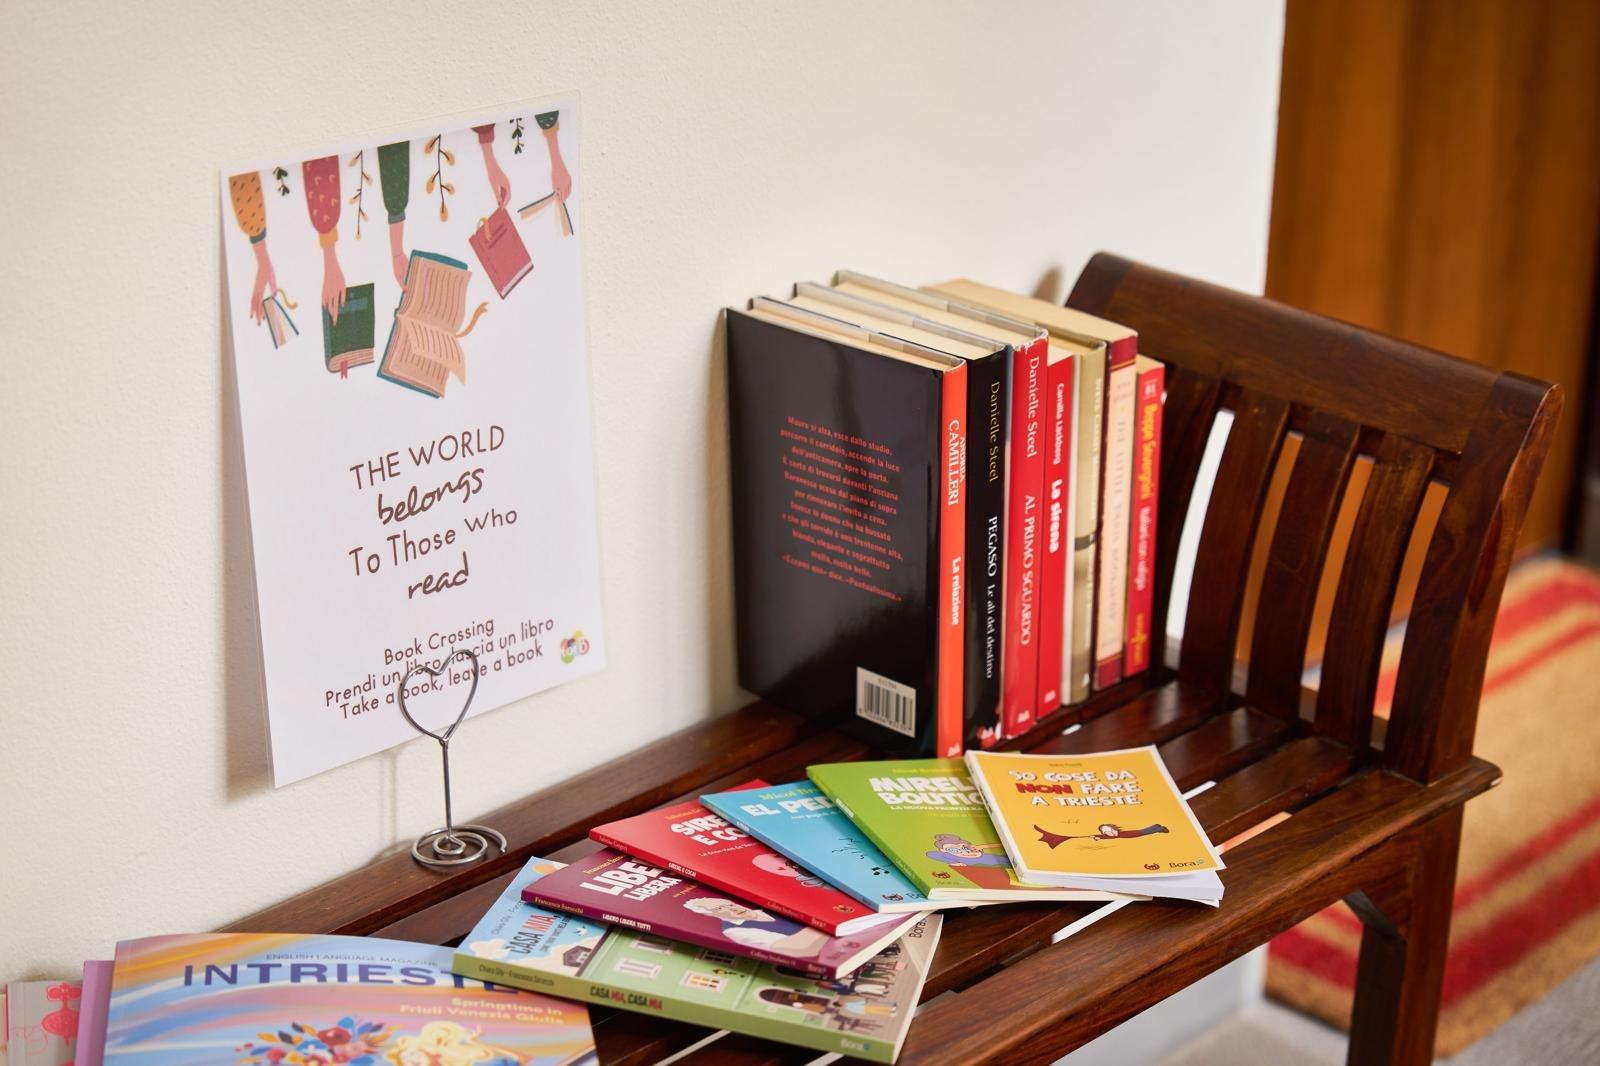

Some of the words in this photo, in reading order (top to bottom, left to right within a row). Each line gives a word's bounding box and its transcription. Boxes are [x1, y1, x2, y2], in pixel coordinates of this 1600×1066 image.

[1026, 356, 1040, 420] Danielle
[990, 381, 1000, 444] Danielle
[1055, 383, 1065, 425] Camilla
[1026, 422, 1038, 458] Steel
[350, 452, 400, 489] THE
[408, 425, 504, 466] WORLD
[948, 420, 960, 506] CAMILLERI
[990, 446, 999, 482] Steel
[378, 468, 484, 525] belongs
[1024, 495, 1036, 514] AL
[1051, 480, 1063, 500] La
[1050, 502, 1060, 552] sirena
[349, 546, 380, 576] To
[387, 530, 456, 566] Those
[986, 516, 998, 577] PEGASO
[1023, 517, 1036, 568] PRIMO
[408, 552, 469, 599] read
[952, 556, 961, 574] La
[952, 577, 962, 626] relazione
[988, 584, 996, 597] Le
[988, 600, 996, 614] ali
[1021, 570, 1034, 645] SGUARDO
[987, 616, 996, 635] del
[384, 637, 422, 665] Book
[428, 620, 494, 650] Crossing
[986, 636, 996, 679] destino
[326, 674, 376, 707] Prendi
[382, 672, 400, 686] un
[451, 640, 494, 664] lascia
[500, 634, 516, 648] un
[521, 619, 554, 641] libro
[340, 696, 378, 718] Take
[386, 692, 394, 704] a
[450, 664, 487, 686] leave
[494, 658, 502, 671] a
[507, 639, 543, 667] book
[868, 776, 977, 792] MIREL
[1016, 783, 1073, 794] NON
[1080, 781, 1141, 793] FARE
[1044, 772, 1097, 781] COSE
[1104, 770, 1136, 780] DA
[740, 803, 781, 816] EL
[1031, 796, 1049, 805] A
[1053, 794, 1142, 806] TRIESTE
[670, 814, 729, 836] SIRE
[690, 834, 719, 846] E
[712, 828, 750, 841] CO
[579, 861, 662, 896] LIBE
[623, 876, 682, 901] LIBERA
[602, 914, 619, 923] LIBERO
[620, 917, 636, 927] LIBERA
[637, 922, 652, 932] TUTTI
[506, 932, 544, 954] CASA
[380, 956, 438, 967] MAGAZINE
[452, 998, 544, 1014] Springtime
[590, 986, 610, 1000] CASA
[628, 993, 648, 1007] CASA
[648, 998, 663, 1010] MIA
[400, 1004, 442, 1015] Friuli
[446, 1007, 512, 1021] Venezia
[516, 1012, 565, 1025] Giulia
